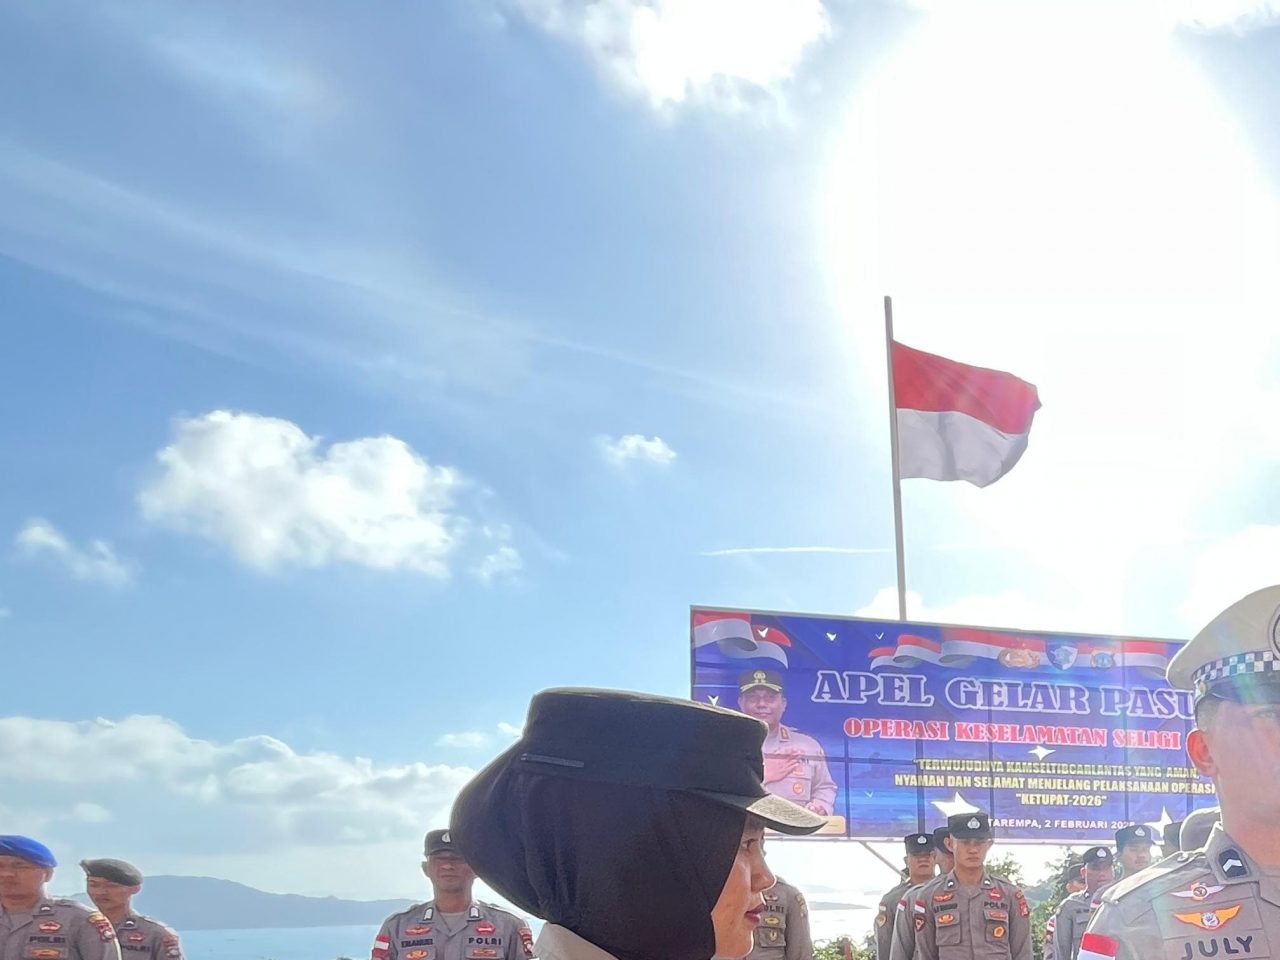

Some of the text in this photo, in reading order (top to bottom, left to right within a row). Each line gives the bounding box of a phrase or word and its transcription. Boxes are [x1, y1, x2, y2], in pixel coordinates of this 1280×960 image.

[811, 670, 935, 707] APEL
[945, 677, 1091, 715] GELAR
[844, 717, 1182, 750] OPERASI KESELAMATAN SELIGI
[1134, 765, 1162, 778] YANG
[894, 774, 1216, 795] NYAMAN DAN SELAMAT MENJELANG PELAKSANAAN OPERASI
[1015, 793, 1107, 806] "KETUPAT-2026"
[988, 818, 1041, 829] TAREMPA,
[1044, 819, 1051, 828] 2
[1054, 820, 1108, 829] FEBRUARI
[468, 937, 502, 945] POLRI
[1181, 935, 1253, 960] JULY
